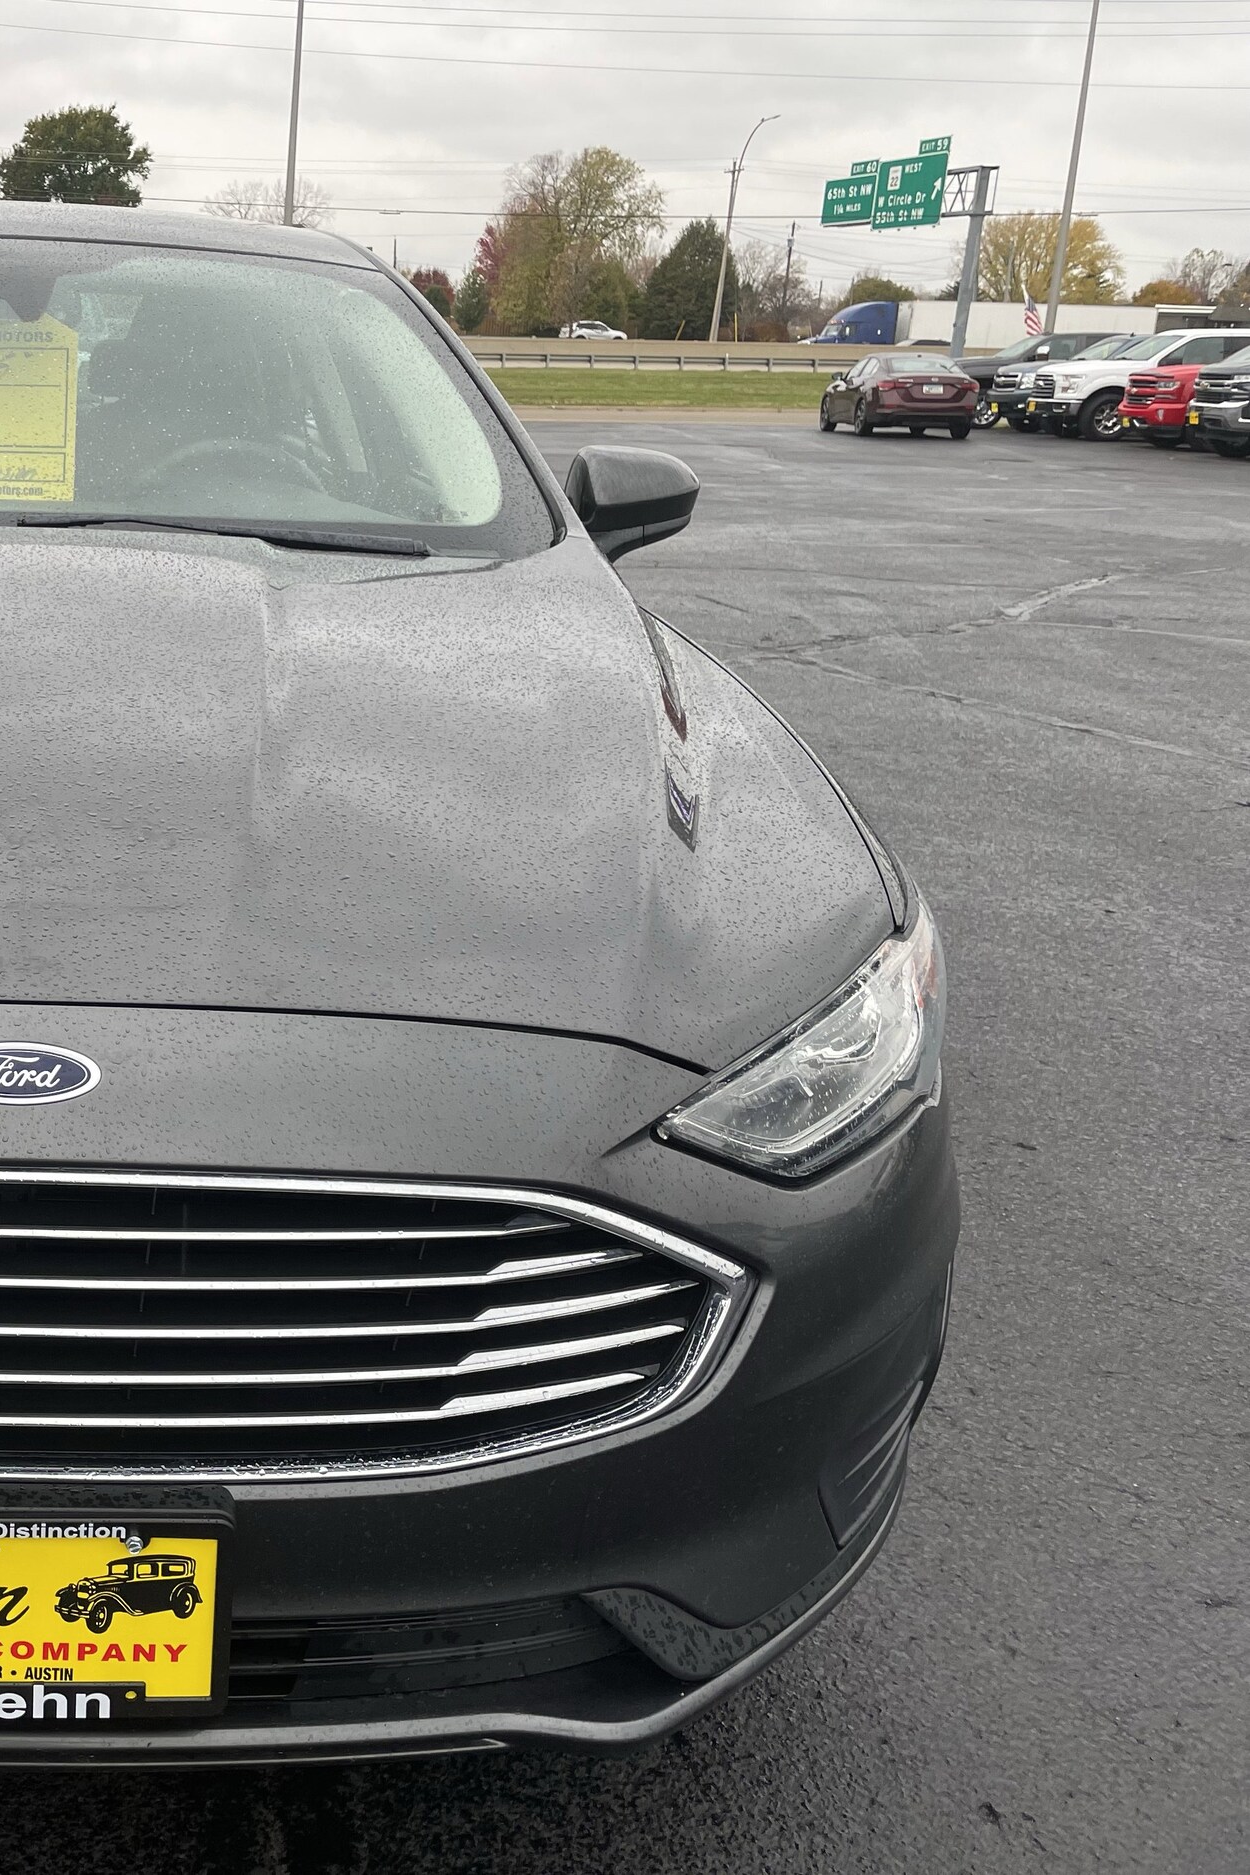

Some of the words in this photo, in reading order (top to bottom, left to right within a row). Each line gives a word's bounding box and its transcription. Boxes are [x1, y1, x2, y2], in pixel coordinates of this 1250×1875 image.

[921, 141, 935, 152] EXIT
[937, 138, 948, 150] 59
[853, 164, 864, 173] EXIT
[866, 161, 877, 173] 60
[904, 162, 923, 173] WEST
[890, 176, 899, 187] 22
[827, 187, 846, 200] 65th
[849, 185, 858, 197] St
[860, 184, 873, 196] NW
[878, 196, 885, 208] W
[888, 193, 912, 207] Circle
[915, 191, 926, 204] Dr
[845, 203, 861, 212] MILES
[875, 211, 895, 224] 55th
[898, 209, 908, 222] St
[910, 207, 925, 220] NW
[24, 1666, 74, 1681] AUSTIN
